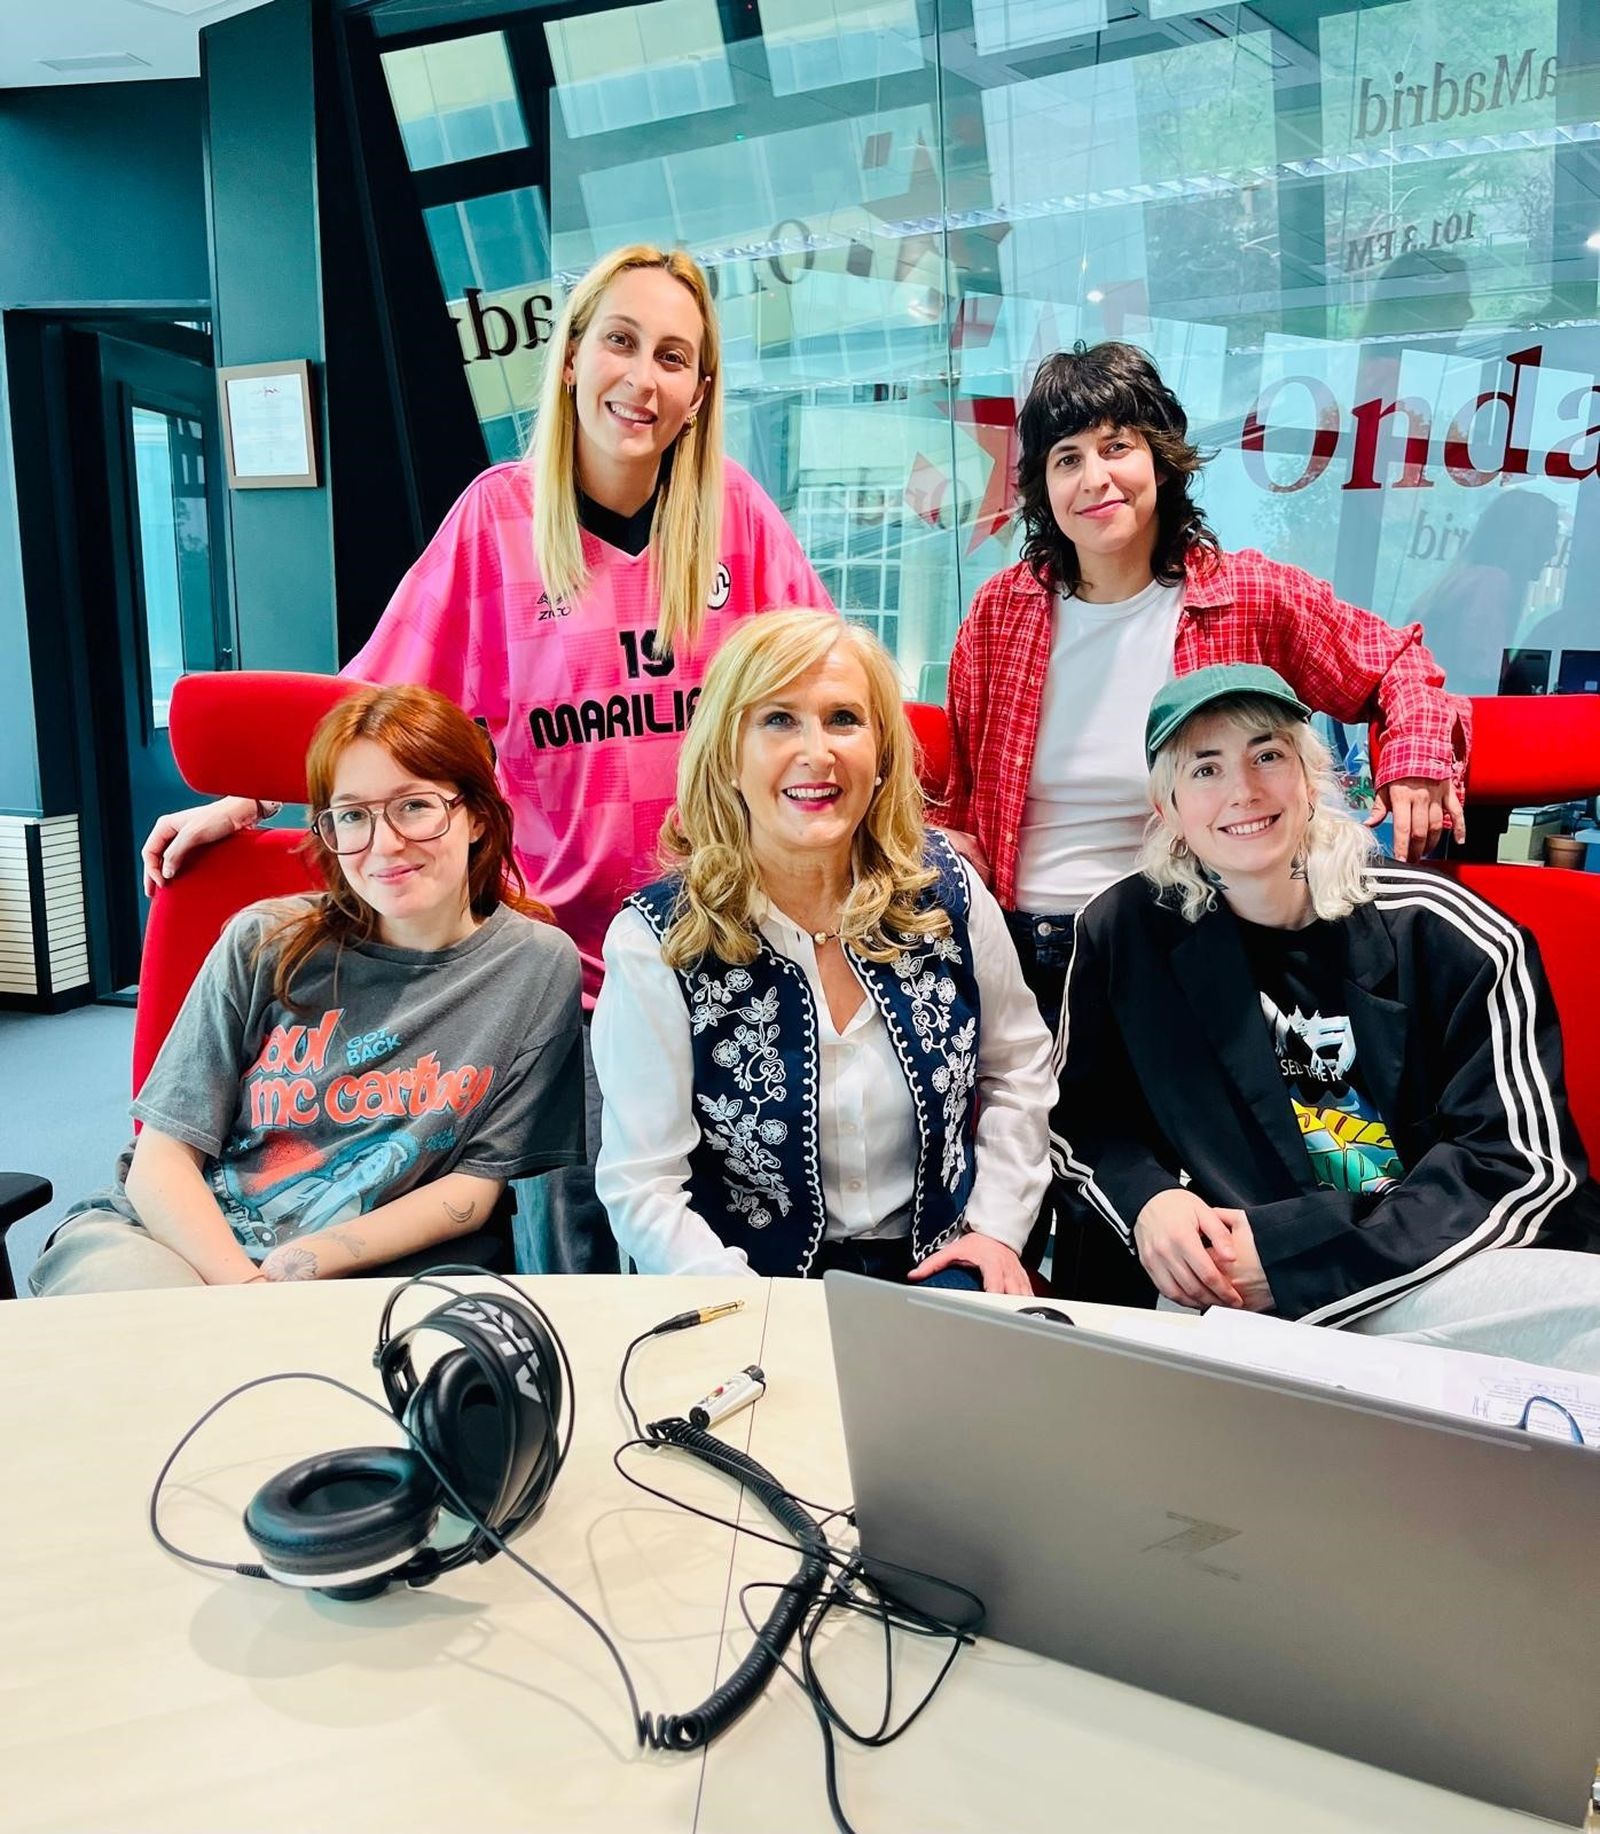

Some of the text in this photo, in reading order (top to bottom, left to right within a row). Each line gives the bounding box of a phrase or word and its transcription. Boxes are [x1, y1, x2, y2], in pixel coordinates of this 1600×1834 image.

[1241, 345, 1600, 494] Onda
[619, 629, 675, 679] 19
[346, 1027, 390, 1049] GOT
[346, 1033, 402, 1067] BACK
